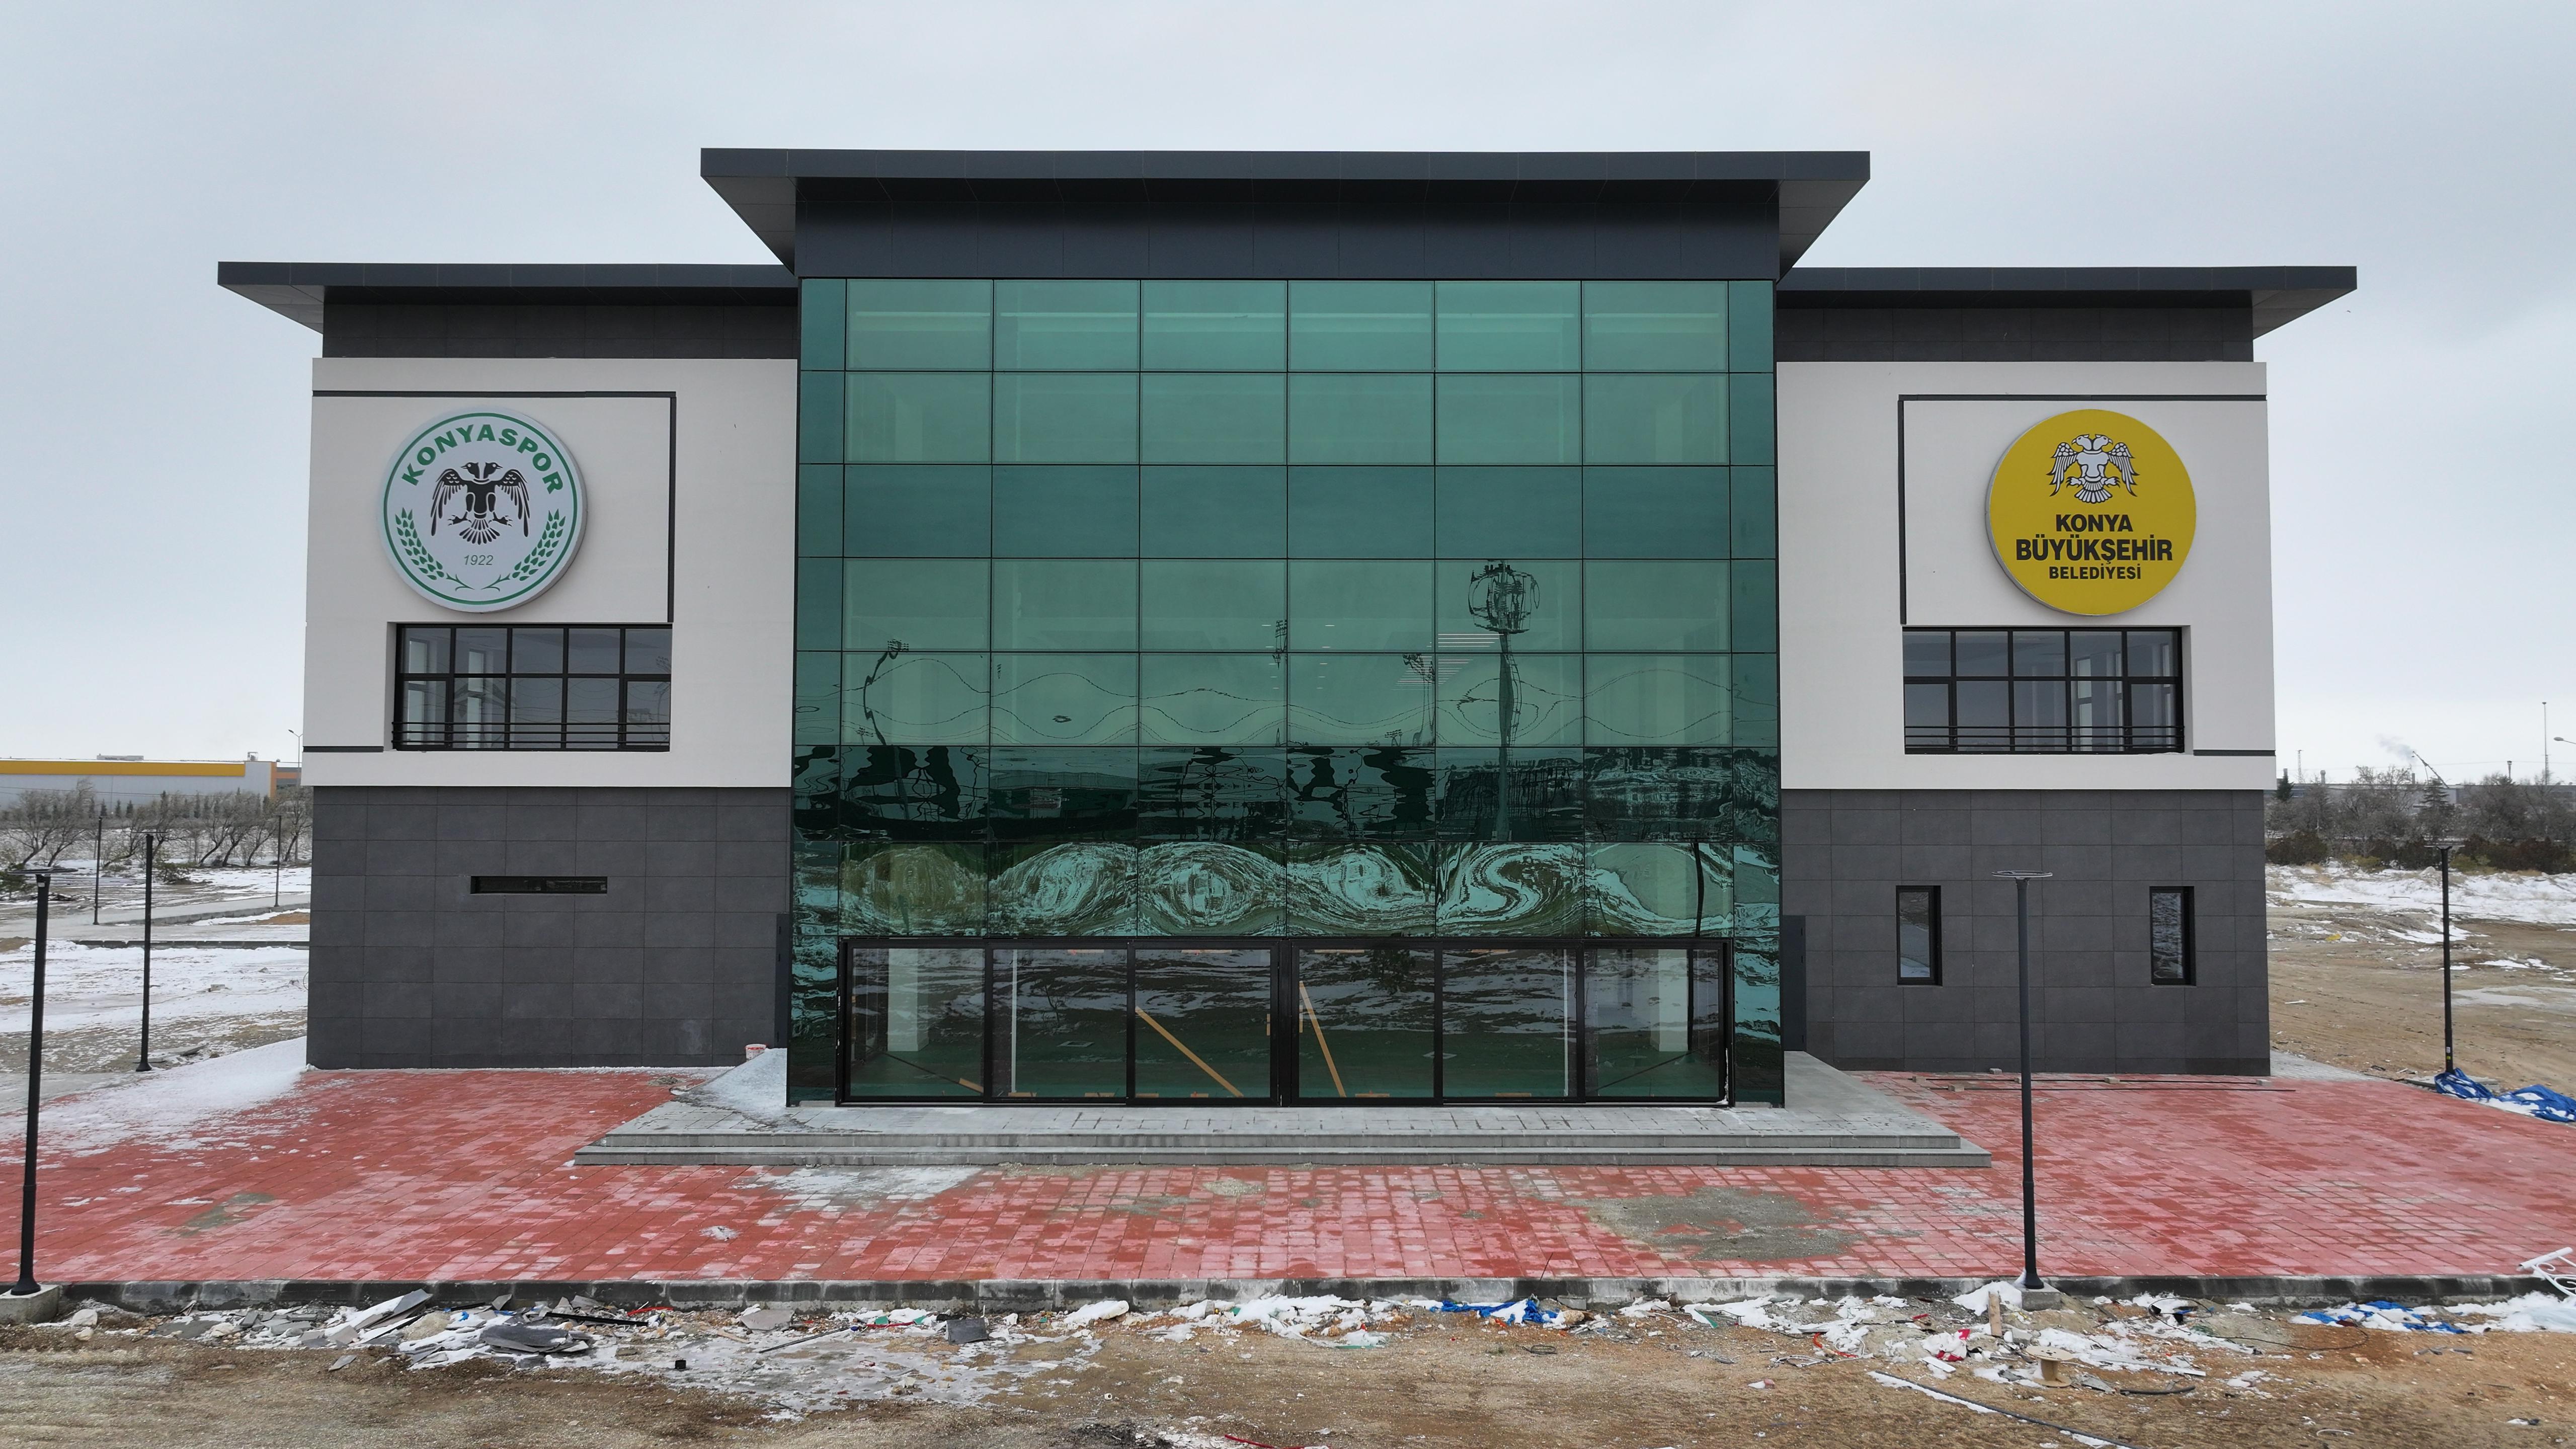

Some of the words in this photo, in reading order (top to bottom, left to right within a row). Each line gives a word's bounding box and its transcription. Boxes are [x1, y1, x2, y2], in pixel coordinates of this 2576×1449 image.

[401, 424, 564, 495] KONYASPOR
[2056, 514, 2133, 532] KONYA
[2016, 534, 2173, 565] BÜYÜKŞEHİR
[463, 554, 494, 566] 1922
[2049, 563, 2141, 580] BELEDİYESİ
